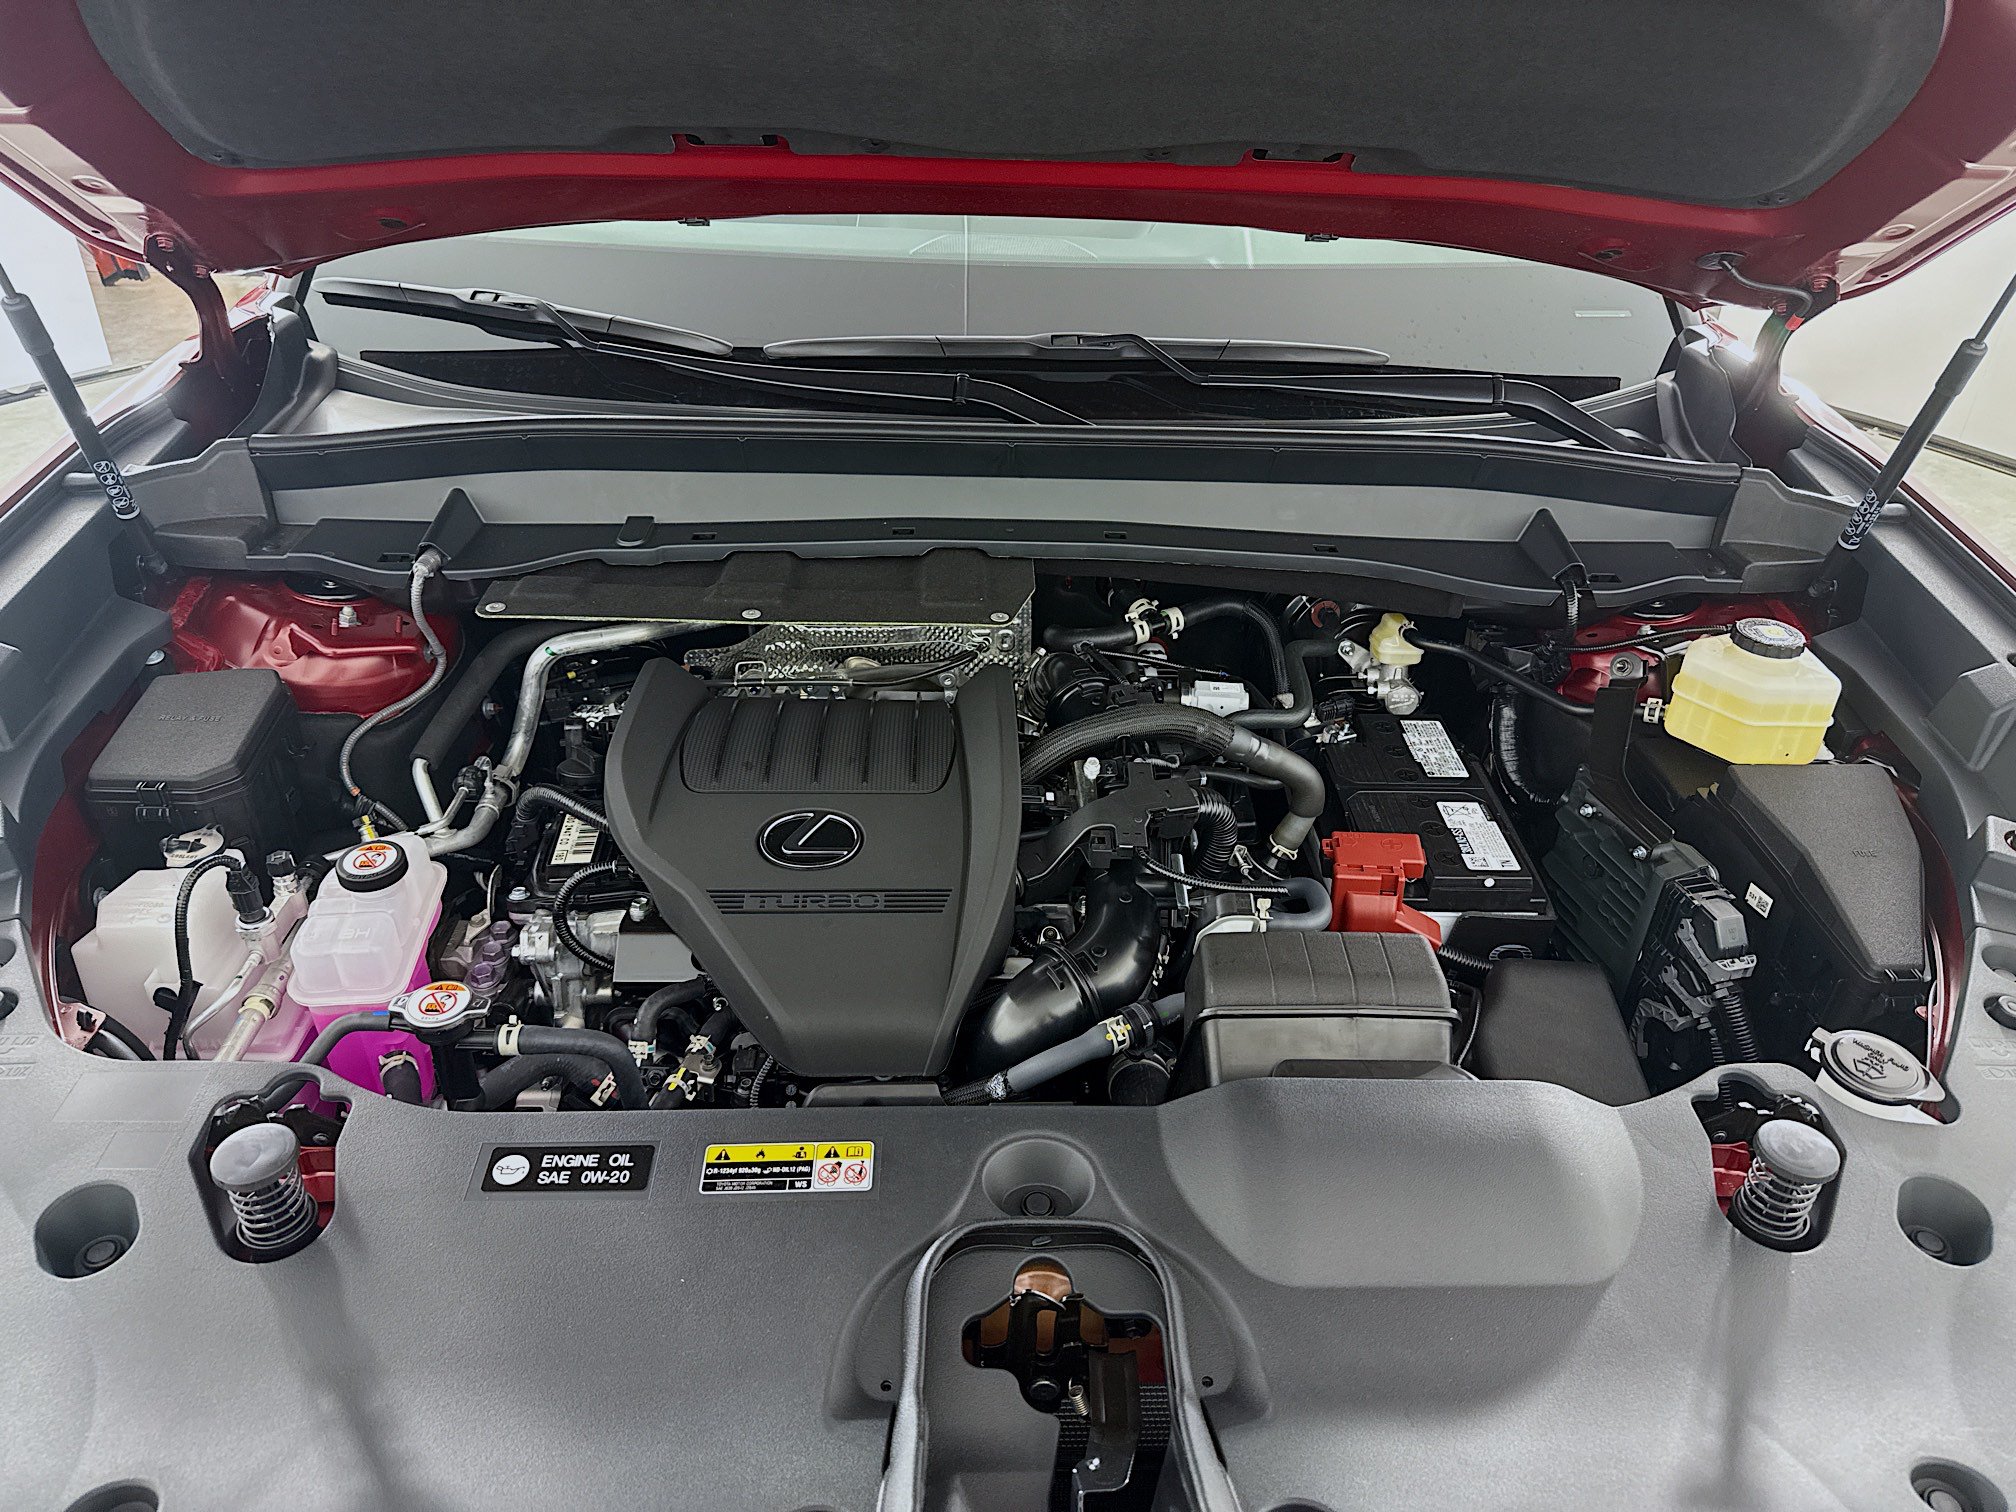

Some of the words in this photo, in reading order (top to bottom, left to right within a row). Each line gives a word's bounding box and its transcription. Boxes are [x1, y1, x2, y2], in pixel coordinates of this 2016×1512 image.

[198, 714, 222, 722] FUSE
[748, 893, 881, 909] TURBO
[541, 1154, 600, 1168] ENGINE
[608, 1153, 635, 1167] OIL
[536, 1171, 571, 1185] SAE
[580, 1170, 630, 1184] 0W-20
[713, 1167, 738, 1175] R-1234yf
